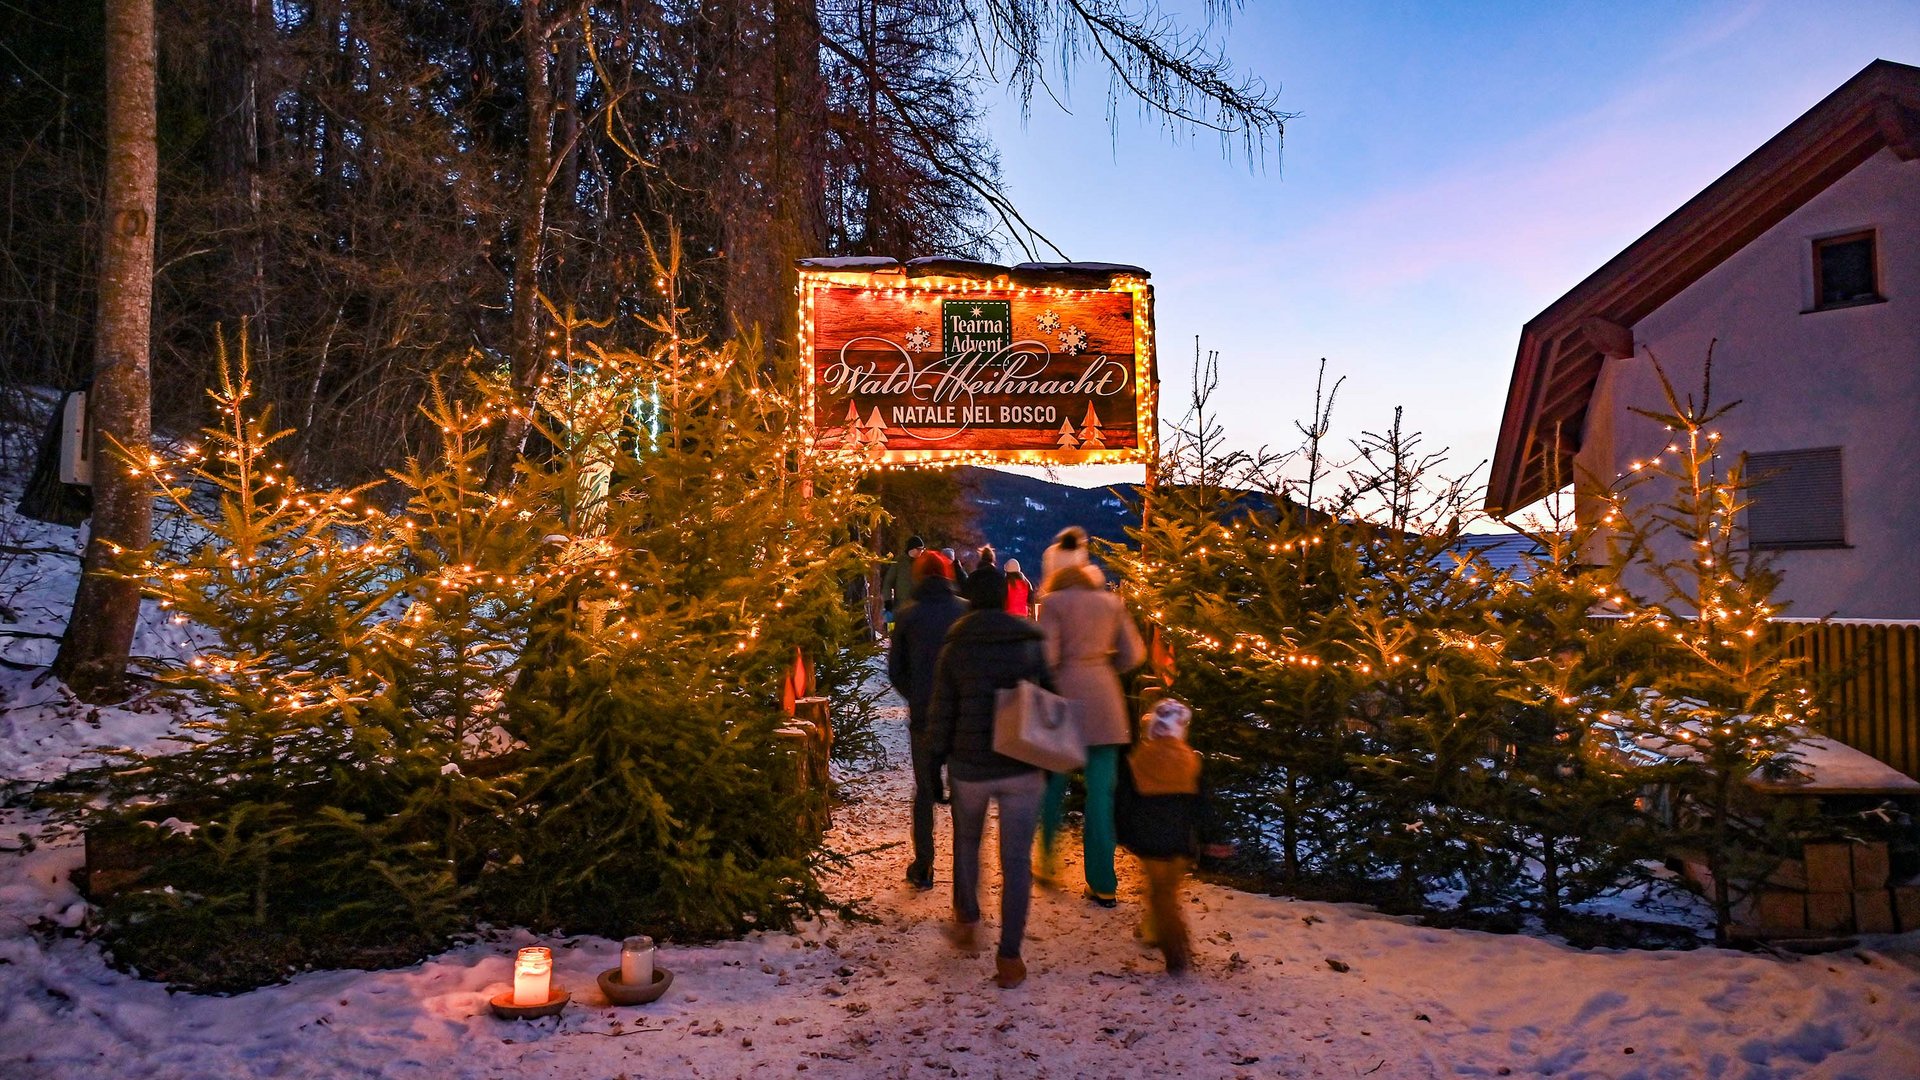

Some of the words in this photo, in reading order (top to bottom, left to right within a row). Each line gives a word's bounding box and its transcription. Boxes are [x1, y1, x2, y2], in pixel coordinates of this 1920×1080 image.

[950, 315, 1003, 334] Tearna
[951, 334, 1003, 353] Advent
[892, 405, 956, 424] NATALE
[962, 405, 995, 424] NEL
[1000, 405, 1057, 424] BOSCO
